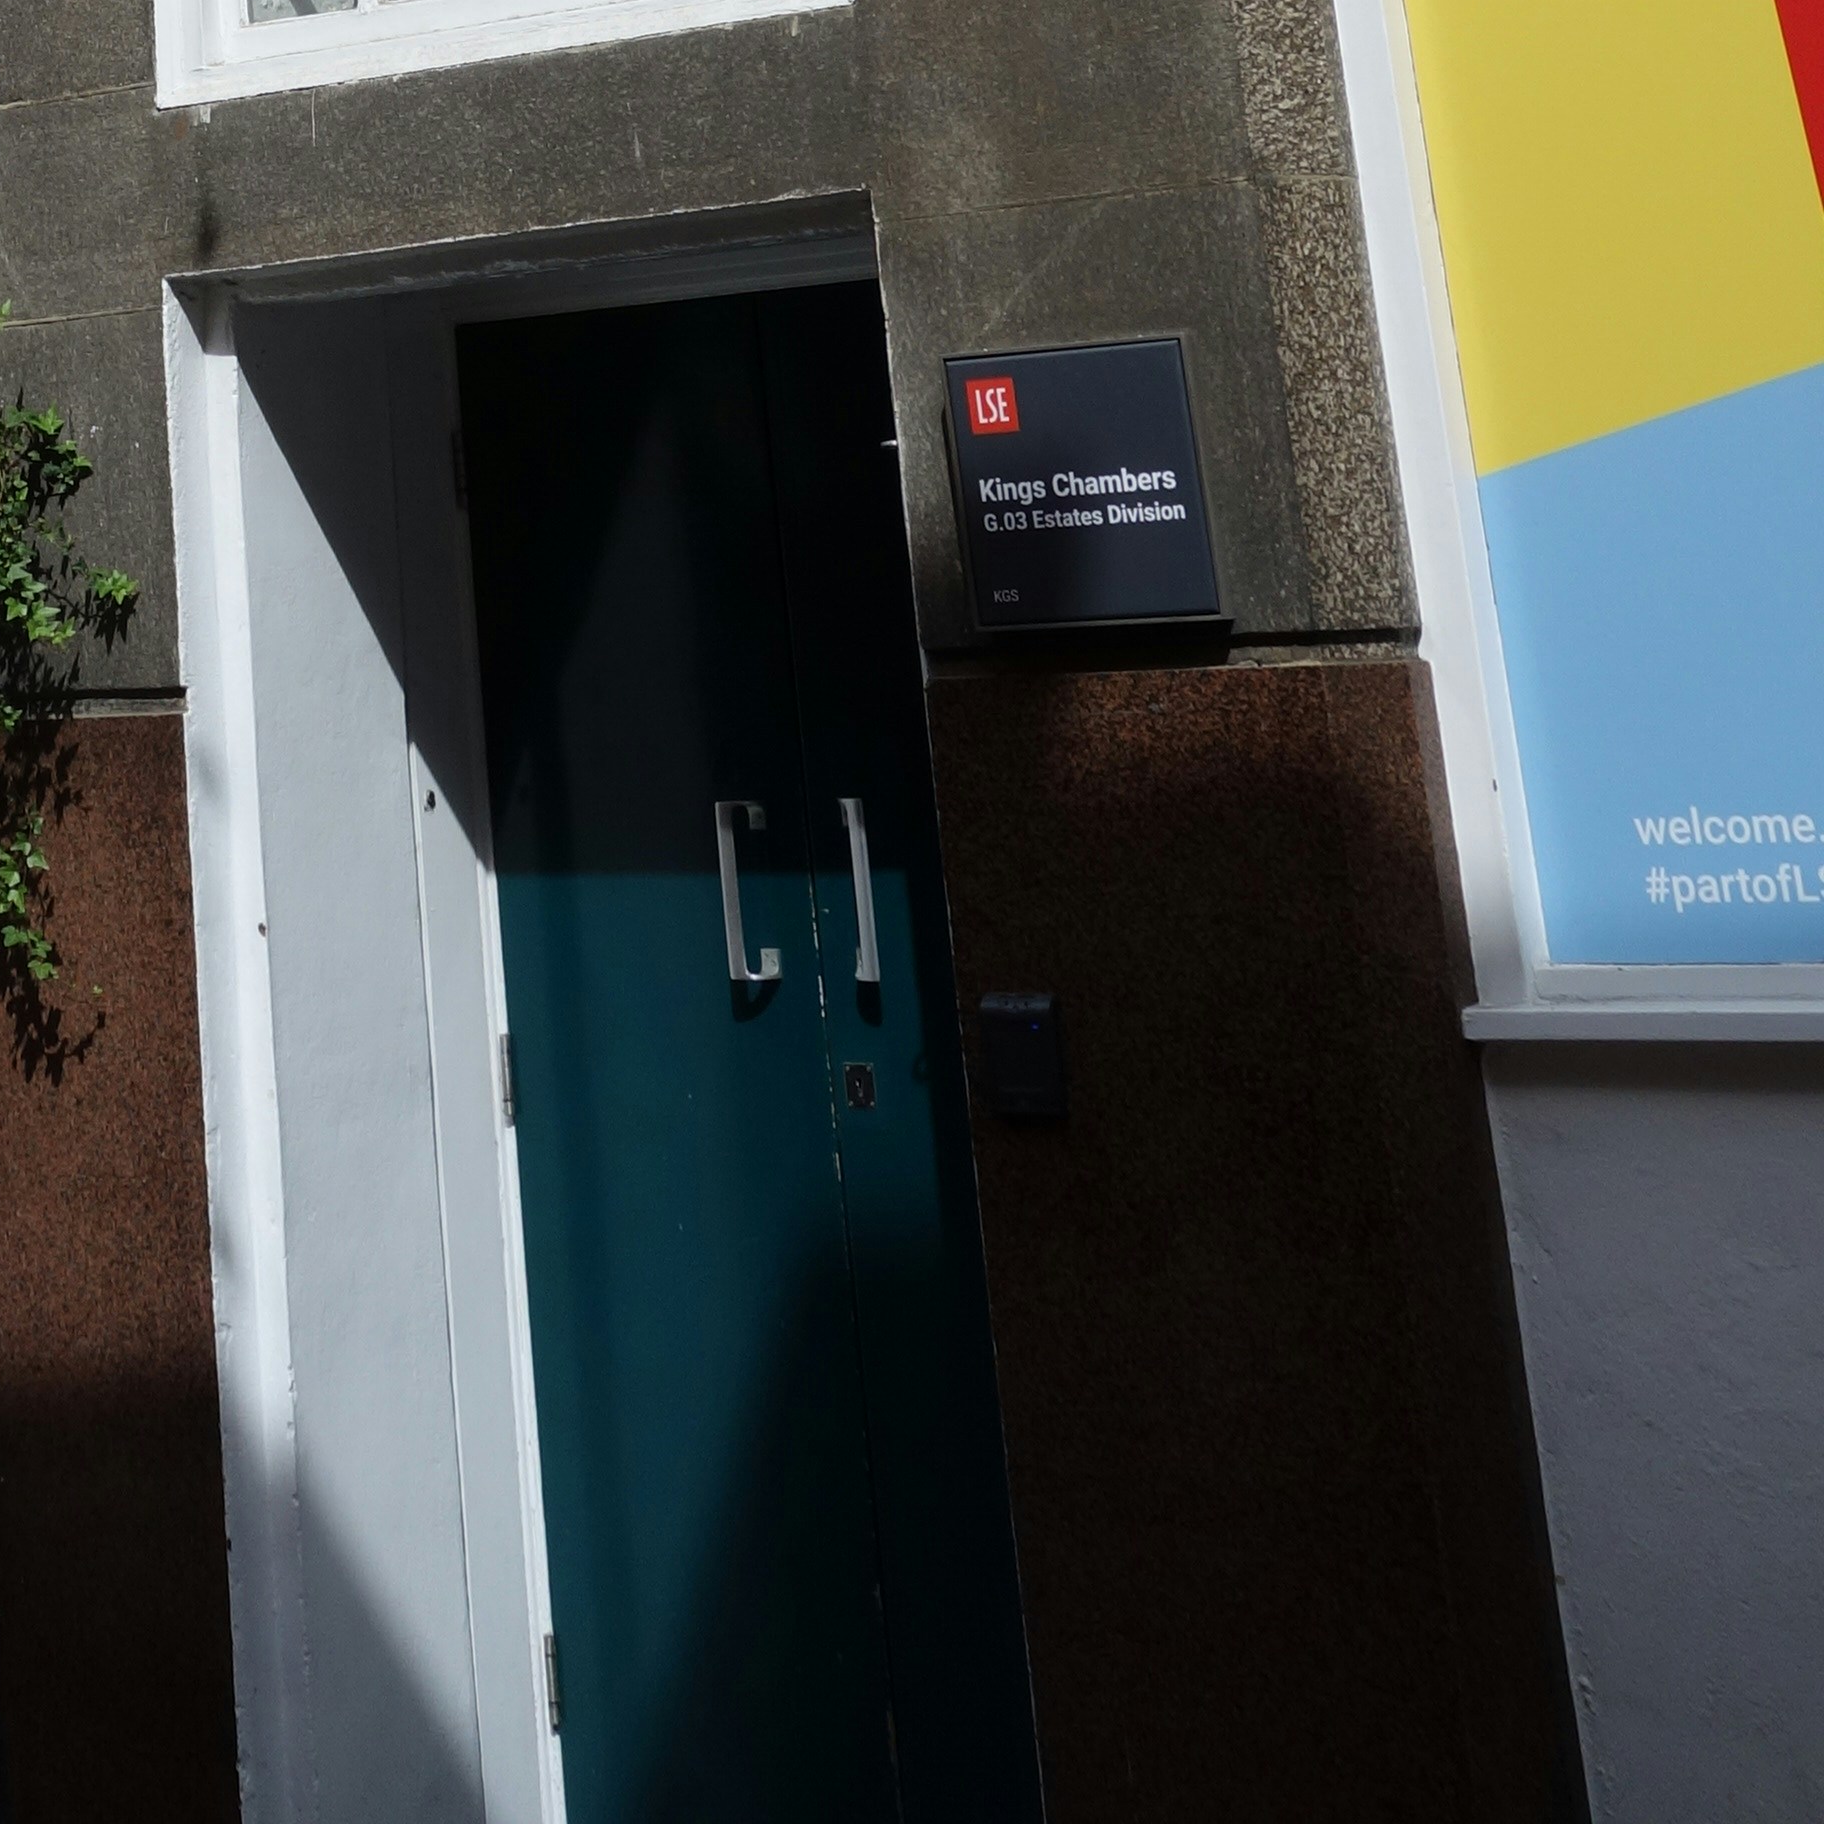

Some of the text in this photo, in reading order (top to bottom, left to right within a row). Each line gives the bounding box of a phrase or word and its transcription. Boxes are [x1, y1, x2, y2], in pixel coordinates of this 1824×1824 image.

[975, 387, 1010, 424] LSE
[978, 467, 1177, 505] Kings Chambers
[983, 501, 1186, 533] G.03 Estates Division
[993, 589, 1020, 603] KGS
